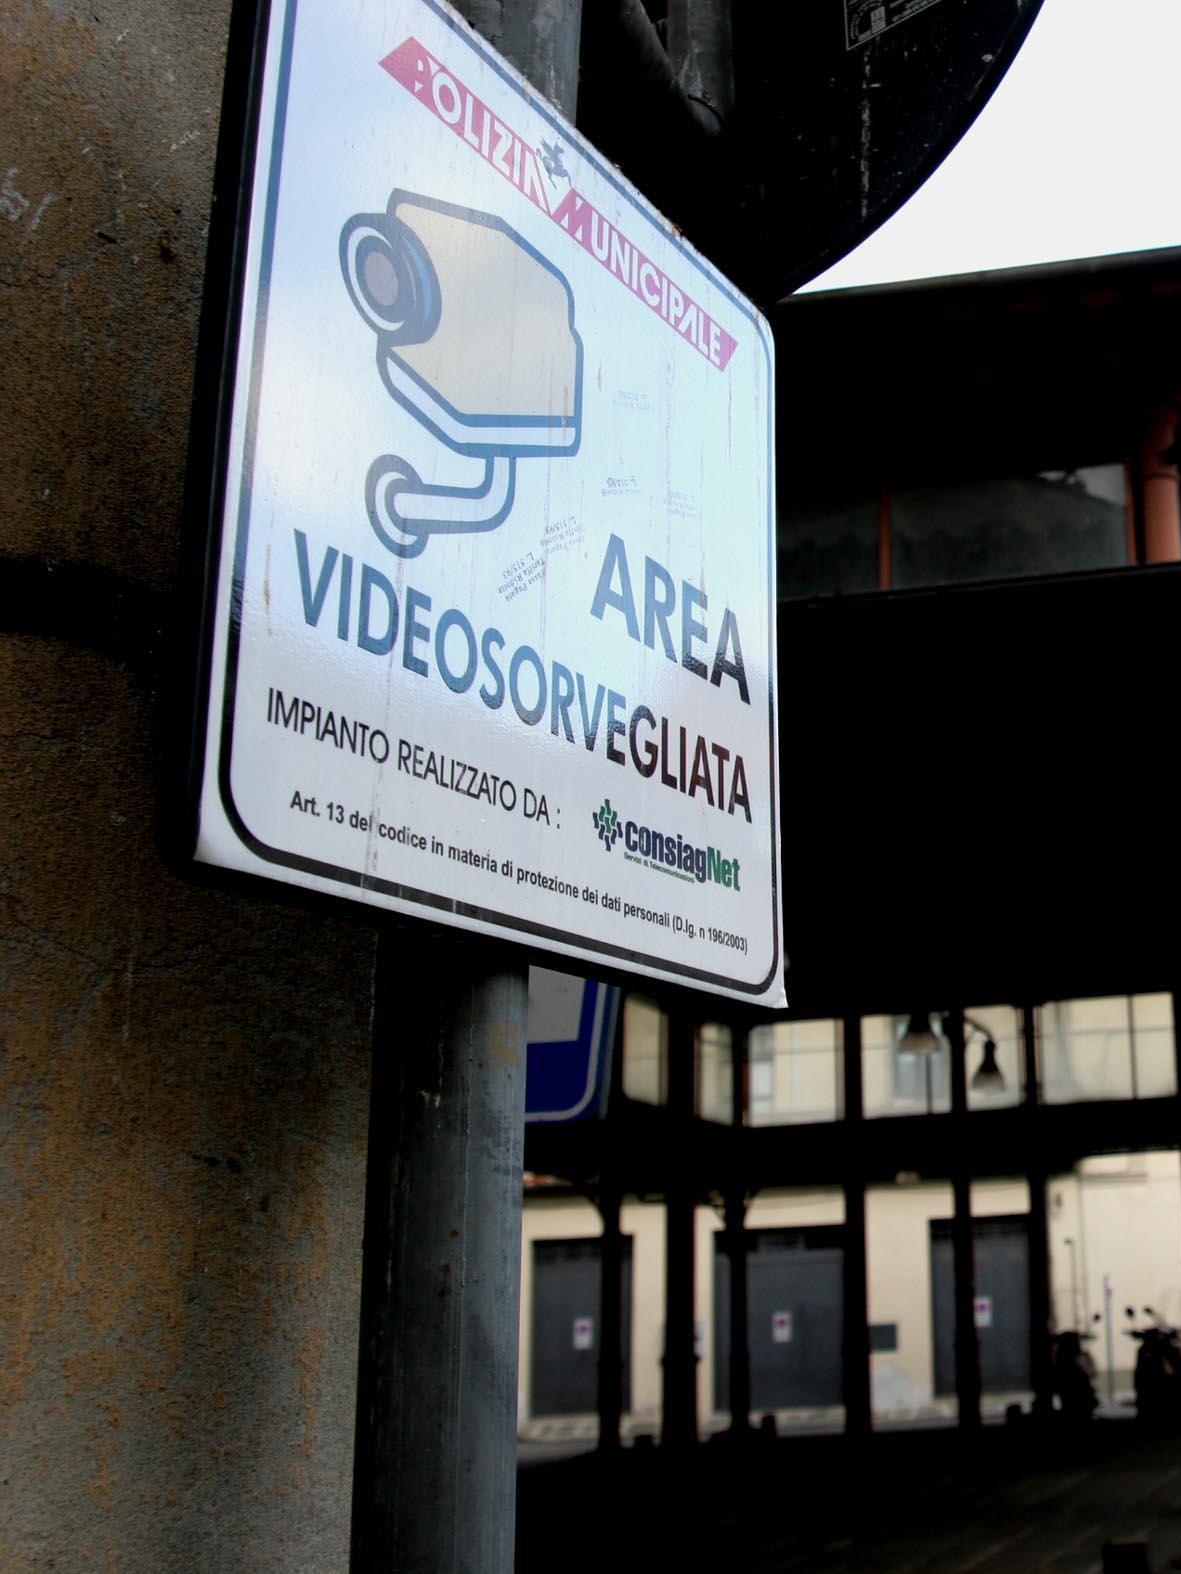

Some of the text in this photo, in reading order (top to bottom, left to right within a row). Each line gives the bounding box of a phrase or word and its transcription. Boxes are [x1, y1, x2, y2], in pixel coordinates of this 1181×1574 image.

[409, 54, 721, 366] POLIZIA MUNICIPALE
[294, 528, 752, 824] VIDEOSORVEGLIATA
[590, 532, 751, 706] AREA
[267, 687, 390, 764] IMPIANTO
[397, 738, 517, 812] REALIZZATO
[290, 790, 320, 817] Art.
[327, 801, 345, 824] 13
[349, 810, 374, 833] del
[378, 822, 427, 850] codice
[431, 836, 444, 856] in
[448, 845, 497, 873] materia
[501, 860, 513, 878] di
[517, 867, 579, 898] protezione
[582, 886, 599, 905] dei
[601, 892, 621, 912] dati
[623, 901, 670, 928] personali
[708, 927, 748, 955] 196/2003)
